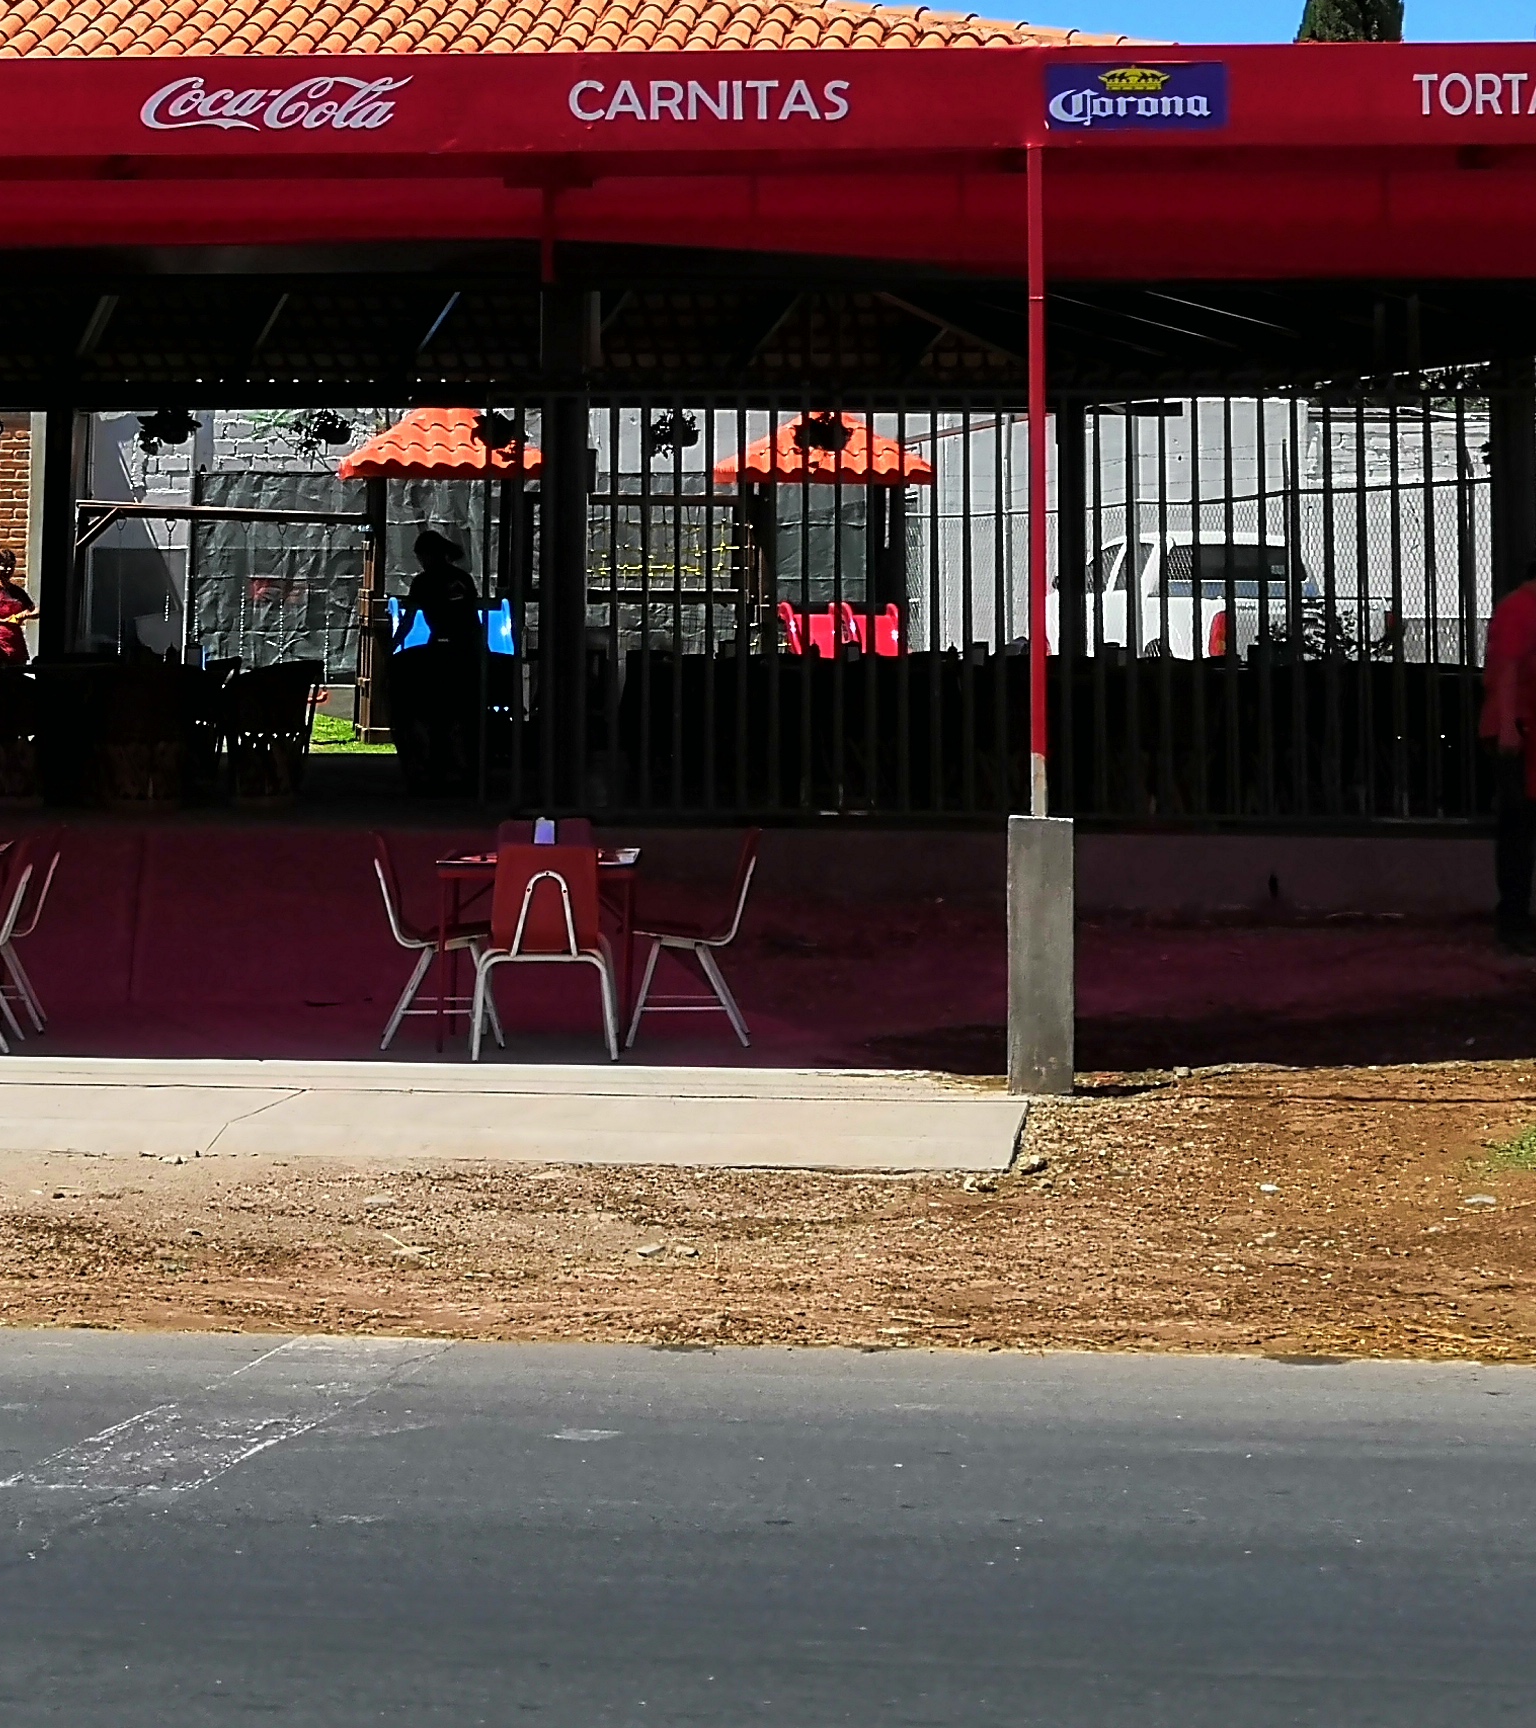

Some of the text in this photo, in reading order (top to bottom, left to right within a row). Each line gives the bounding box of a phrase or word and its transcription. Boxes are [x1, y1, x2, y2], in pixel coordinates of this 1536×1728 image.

[140, 75, 413, 131] Coca-Cola
[568, 79, 850, 121] CARNITAS
[1048, 87, 1211, 127] Corona
